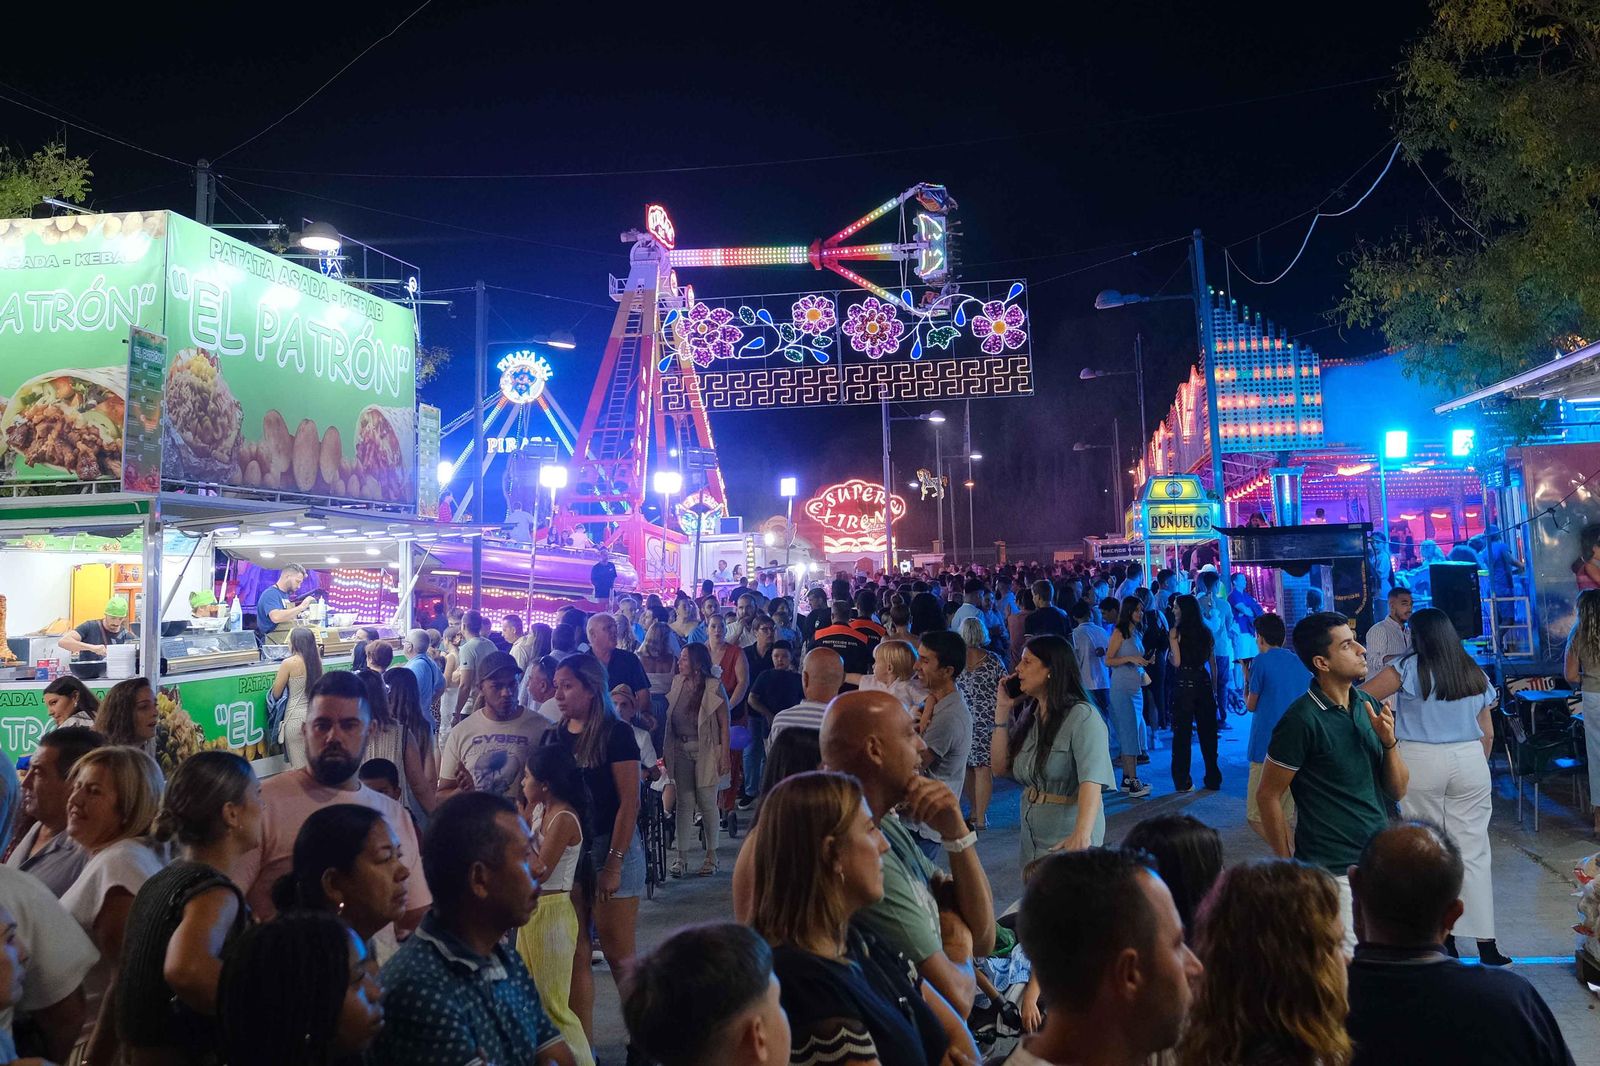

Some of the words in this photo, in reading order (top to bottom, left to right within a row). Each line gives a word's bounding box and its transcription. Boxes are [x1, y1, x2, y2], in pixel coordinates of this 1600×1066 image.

[209, 237, 275, 283] PATATA
[278, 265, 332, 302] ASADA
[340, 287, 385, 322] KEBAB
[486, 436, 552, 454] PIRA
[825, 484, 887, 508] SUPER
[1151, 511, 1210, 529] BUÑUELOS
